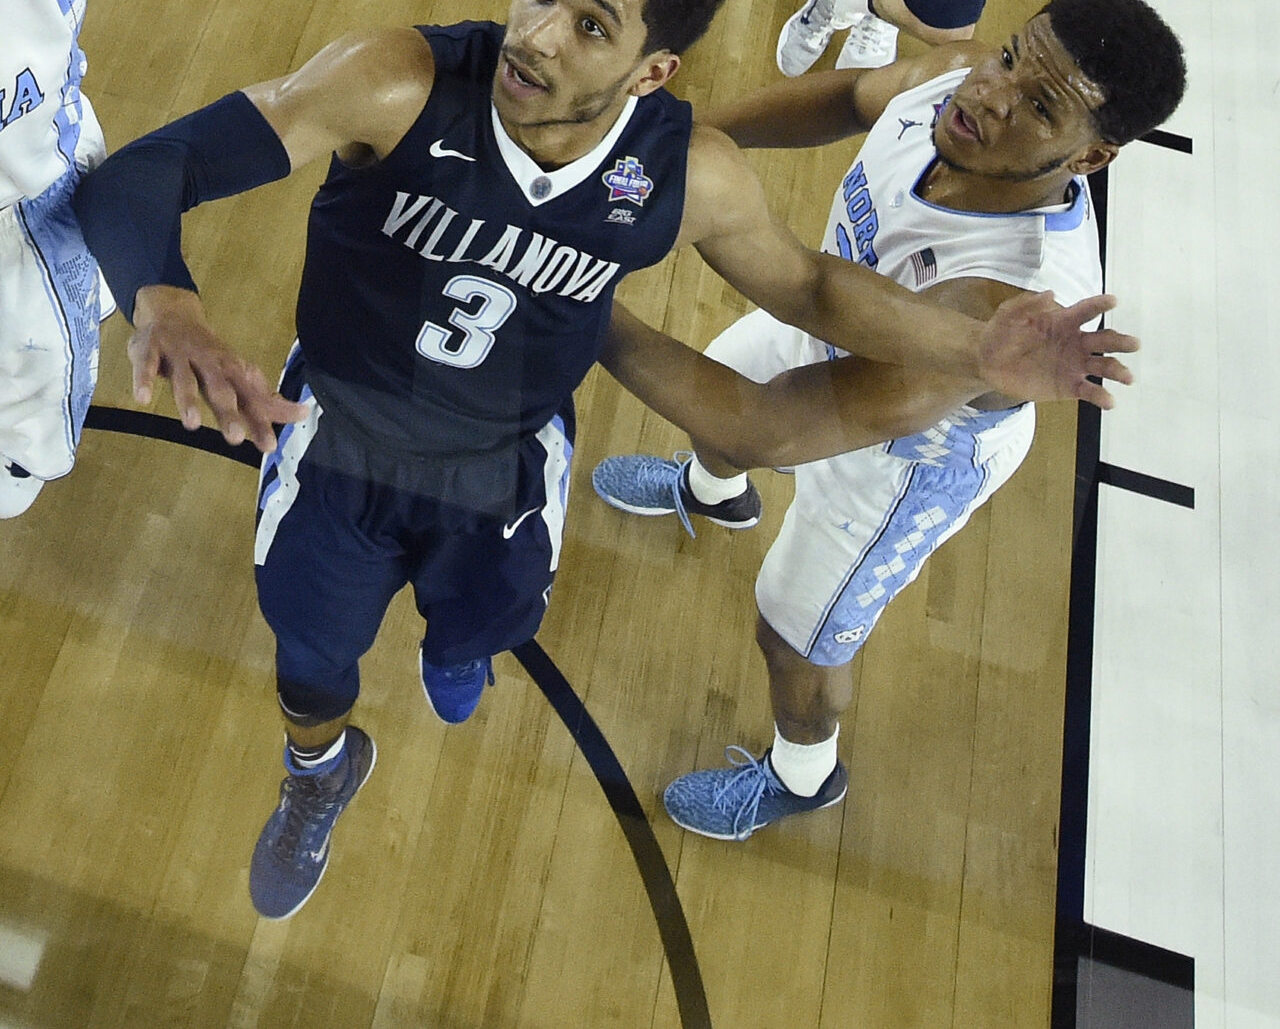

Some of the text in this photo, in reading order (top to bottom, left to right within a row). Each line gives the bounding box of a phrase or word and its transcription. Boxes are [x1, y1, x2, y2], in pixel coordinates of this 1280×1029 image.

[380, 191, 620, 303] VILLANOVA
[843, 161, 879, 271] NORT
[415, 275, 518, 369] 3
